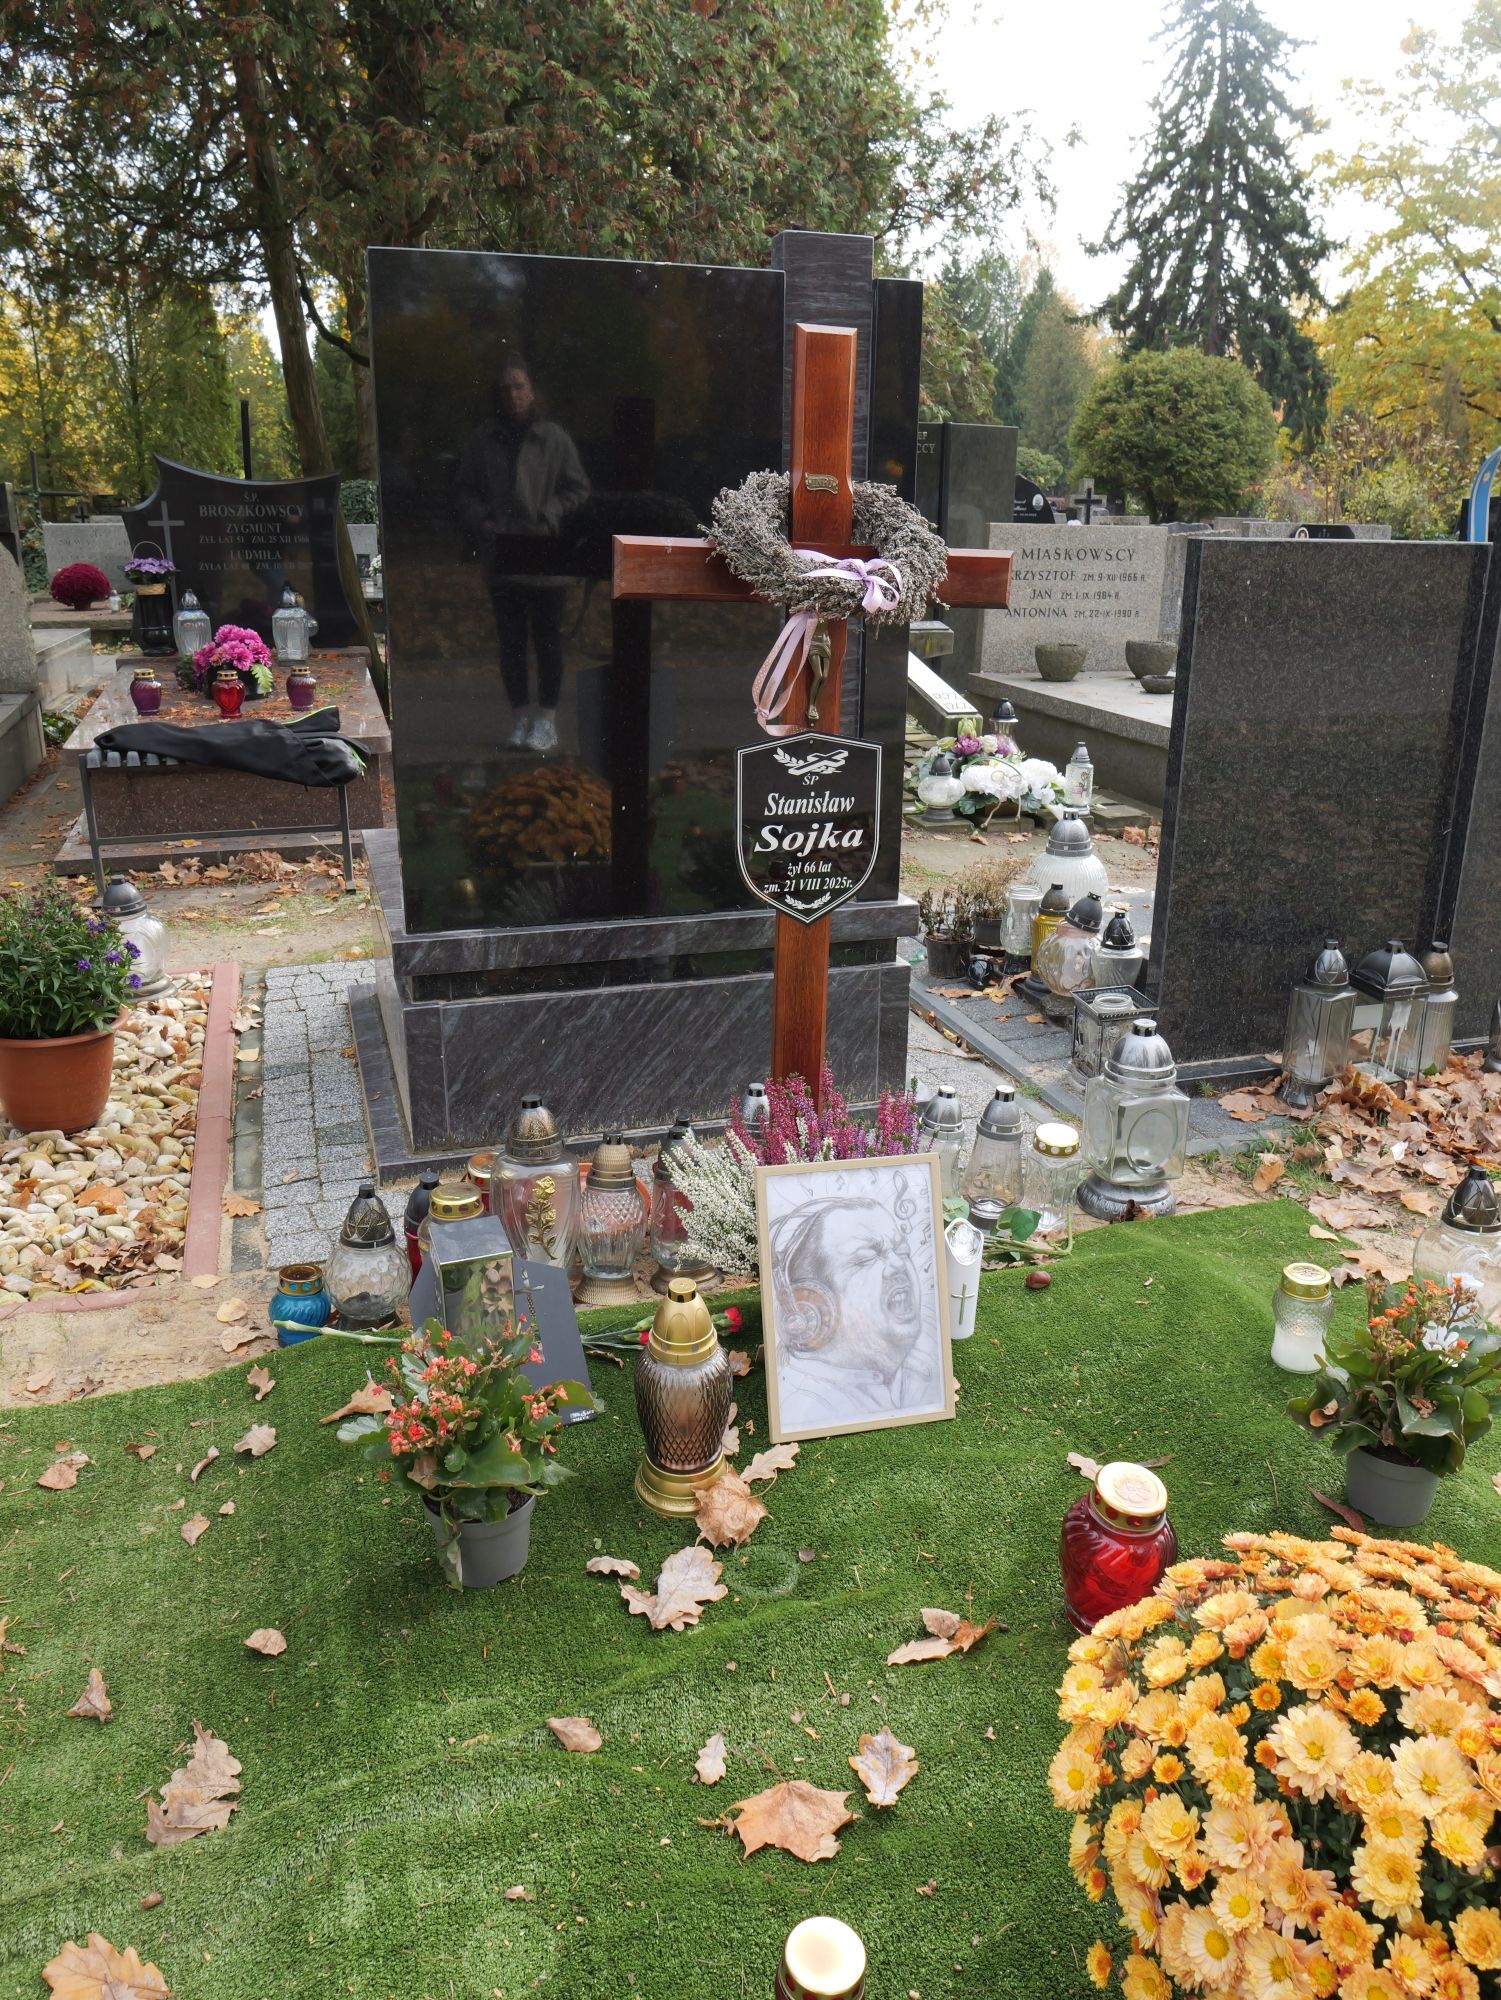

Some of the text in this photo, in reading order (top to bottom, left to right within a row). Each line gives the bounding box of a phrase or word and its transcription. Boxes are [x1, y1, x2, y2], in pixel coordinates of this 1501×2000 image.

[199, 504, 305, 517] BROSZKOWSCY
[226, 523, 282, 534] ZYGMUNT
[1011, 570, 1077, 581] RZYSZTOF
[1030, 589, 1053, 600] JAN
[1004, 607, 1068, 618] ANTONINA
[802, 773, 820, 786] ŚP
[764, 790, 855, 816] Stanisław
[754, 822, 864, 857] Sojka
[803, 861, 816, 874] 66
[818, 860, 832, 873] lat
[764, 876, 853, 894] zm. 21 VIII 2025r.
